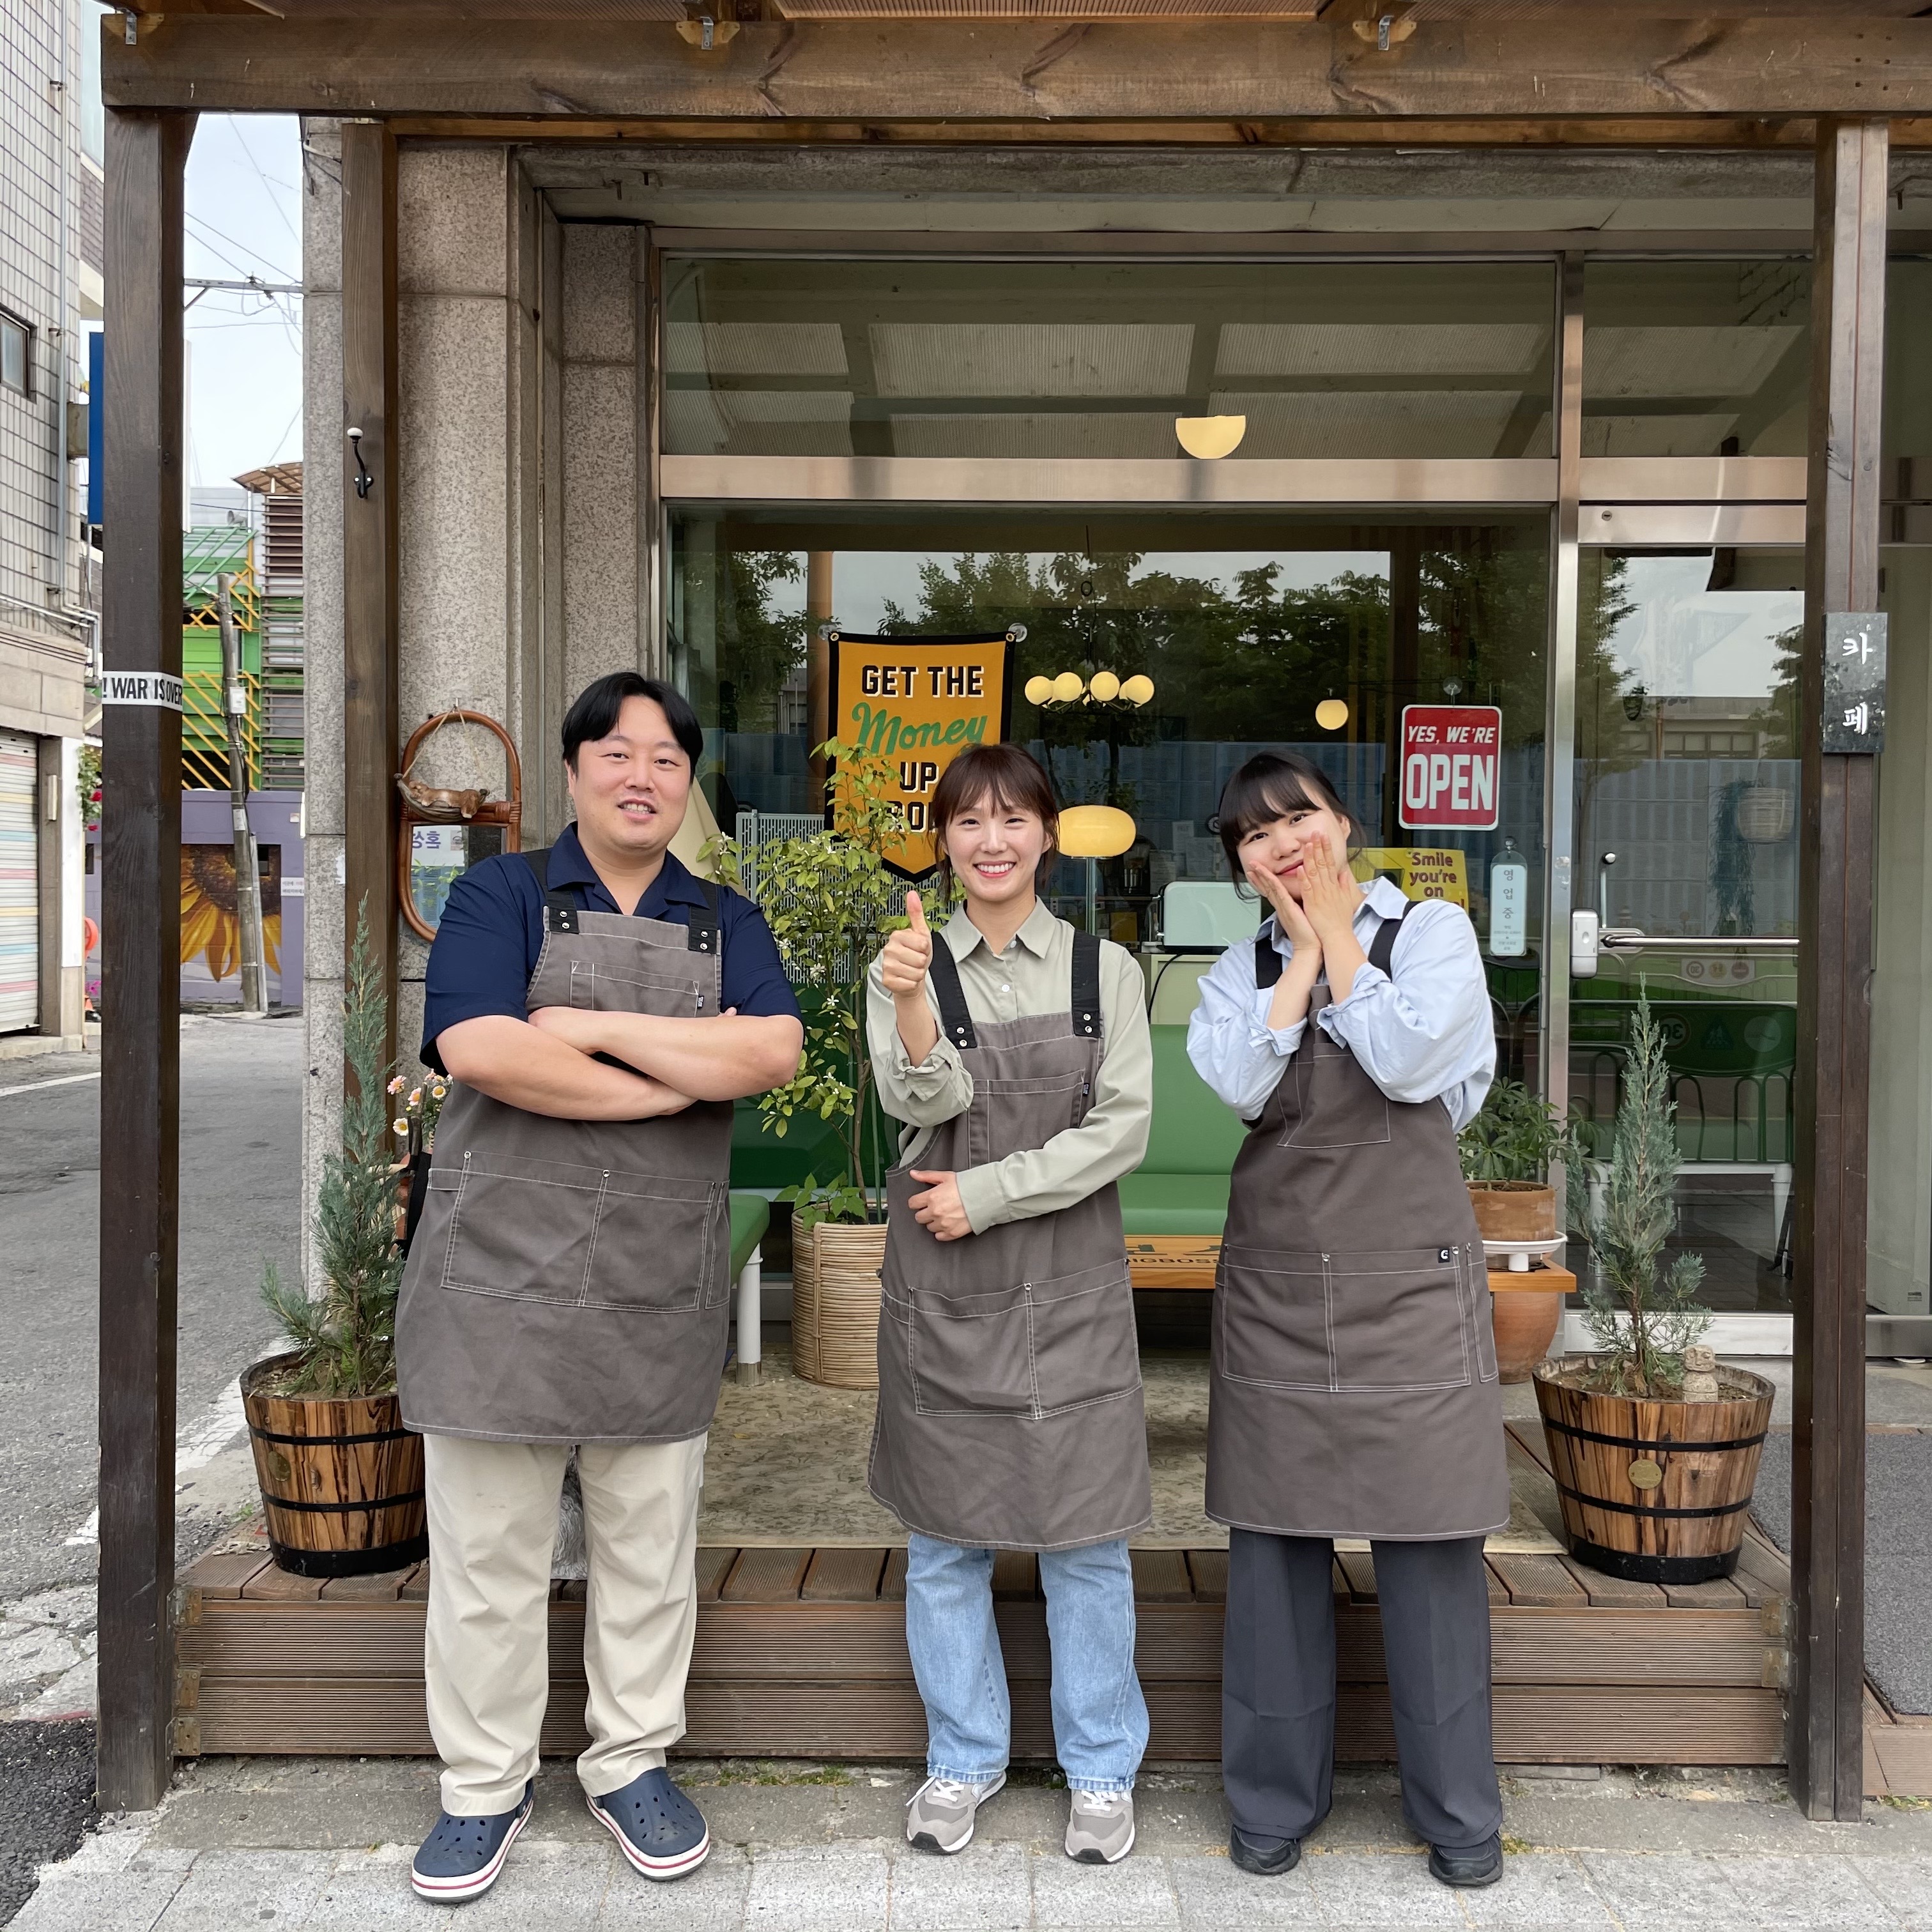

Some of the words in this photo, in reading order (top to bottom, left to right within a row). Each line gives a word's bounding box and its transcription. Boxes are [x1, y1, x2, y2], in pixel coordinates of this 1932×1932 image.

[111, 677, 148, 700] WAR
[154, 678, 165, 700] IS
[166, 681, 183, 706] OVER
[862, 664, 919, 698] GET
[927, 665, 985, 698] THE
[1842, 632, 1873, 735] 카페
[852, 702, 988, 758] Money
[1407, 725, 1440, 745] YES,
[1446, 726, 1496, 743] WE'RE
[900, 761, 940, 793] UP
[1406, 753, 1494, 811] OPEN
[1411, 852, 1453, 867] Smile
[1409, 869, 1457, 887] you're
[1423, 886, 1444, 898] on
[1502, 869, 1514, 919] 영업중
